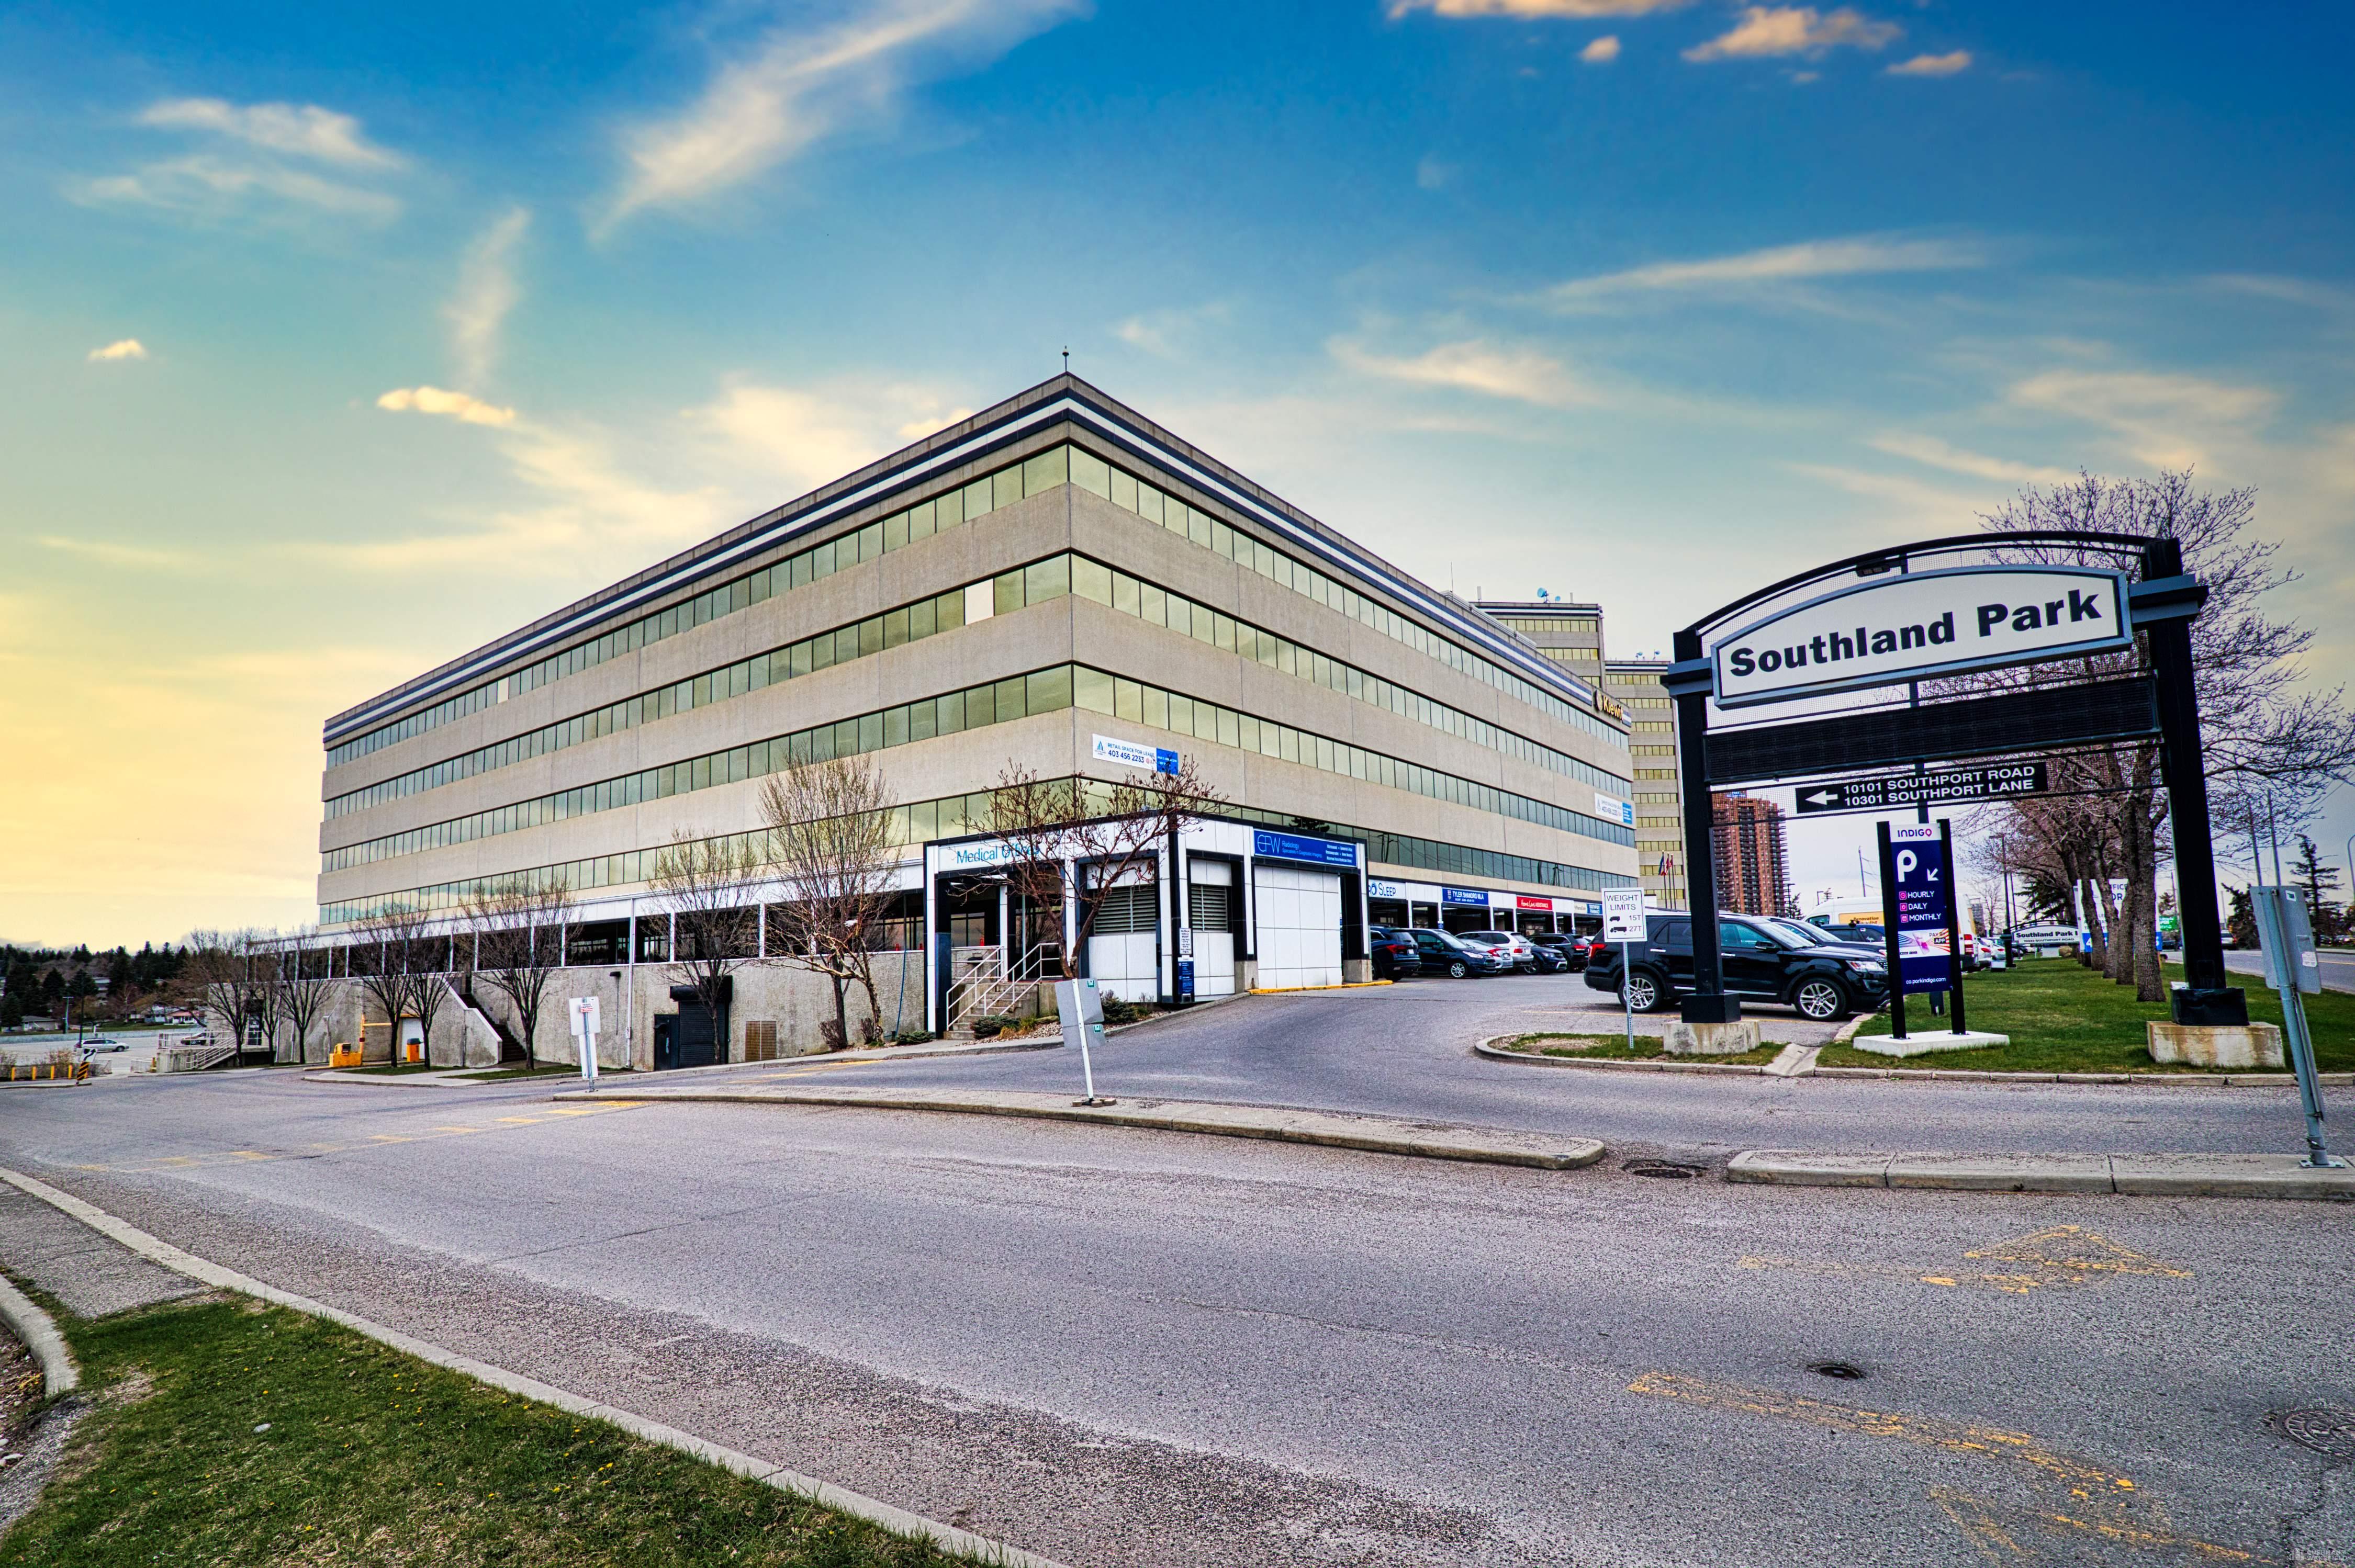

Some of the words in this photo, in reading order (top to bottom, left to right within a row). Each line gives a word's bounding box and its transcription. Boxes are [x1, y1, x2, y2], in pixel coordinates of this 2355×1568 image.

[1730, 611, 1956, 678] Southland
[1977, 589, 2102, 638] Park
[1603, 695, 1623, 720] Kiewit
[1120, 752, 1130, 760] 456
[1131, 754, 1145, 763] 2233
[1844, 782, 1882, 795] 10101
[1887, 771, 1983, 790] SOUTHPORT
[1988, 766, 2035, 779] ROAD
[1845, 794, 1883, 807] 10301
[1888, 784, 1983, 802] SOUTHPORT
[1988, 779, 2034, 793] LANE
[1897, 828, 1932, 838] INDIGO
[1257, 834, 1281, 854] EFW
[1282, 840, 1299, 850] Radiology
[957, 845, 997, 864] Medical
[1897, 849, 1917, 883] P
[1378, 883, 1396, 896] SLEEP
[1908, 890, 1935, 899] HOURLY
